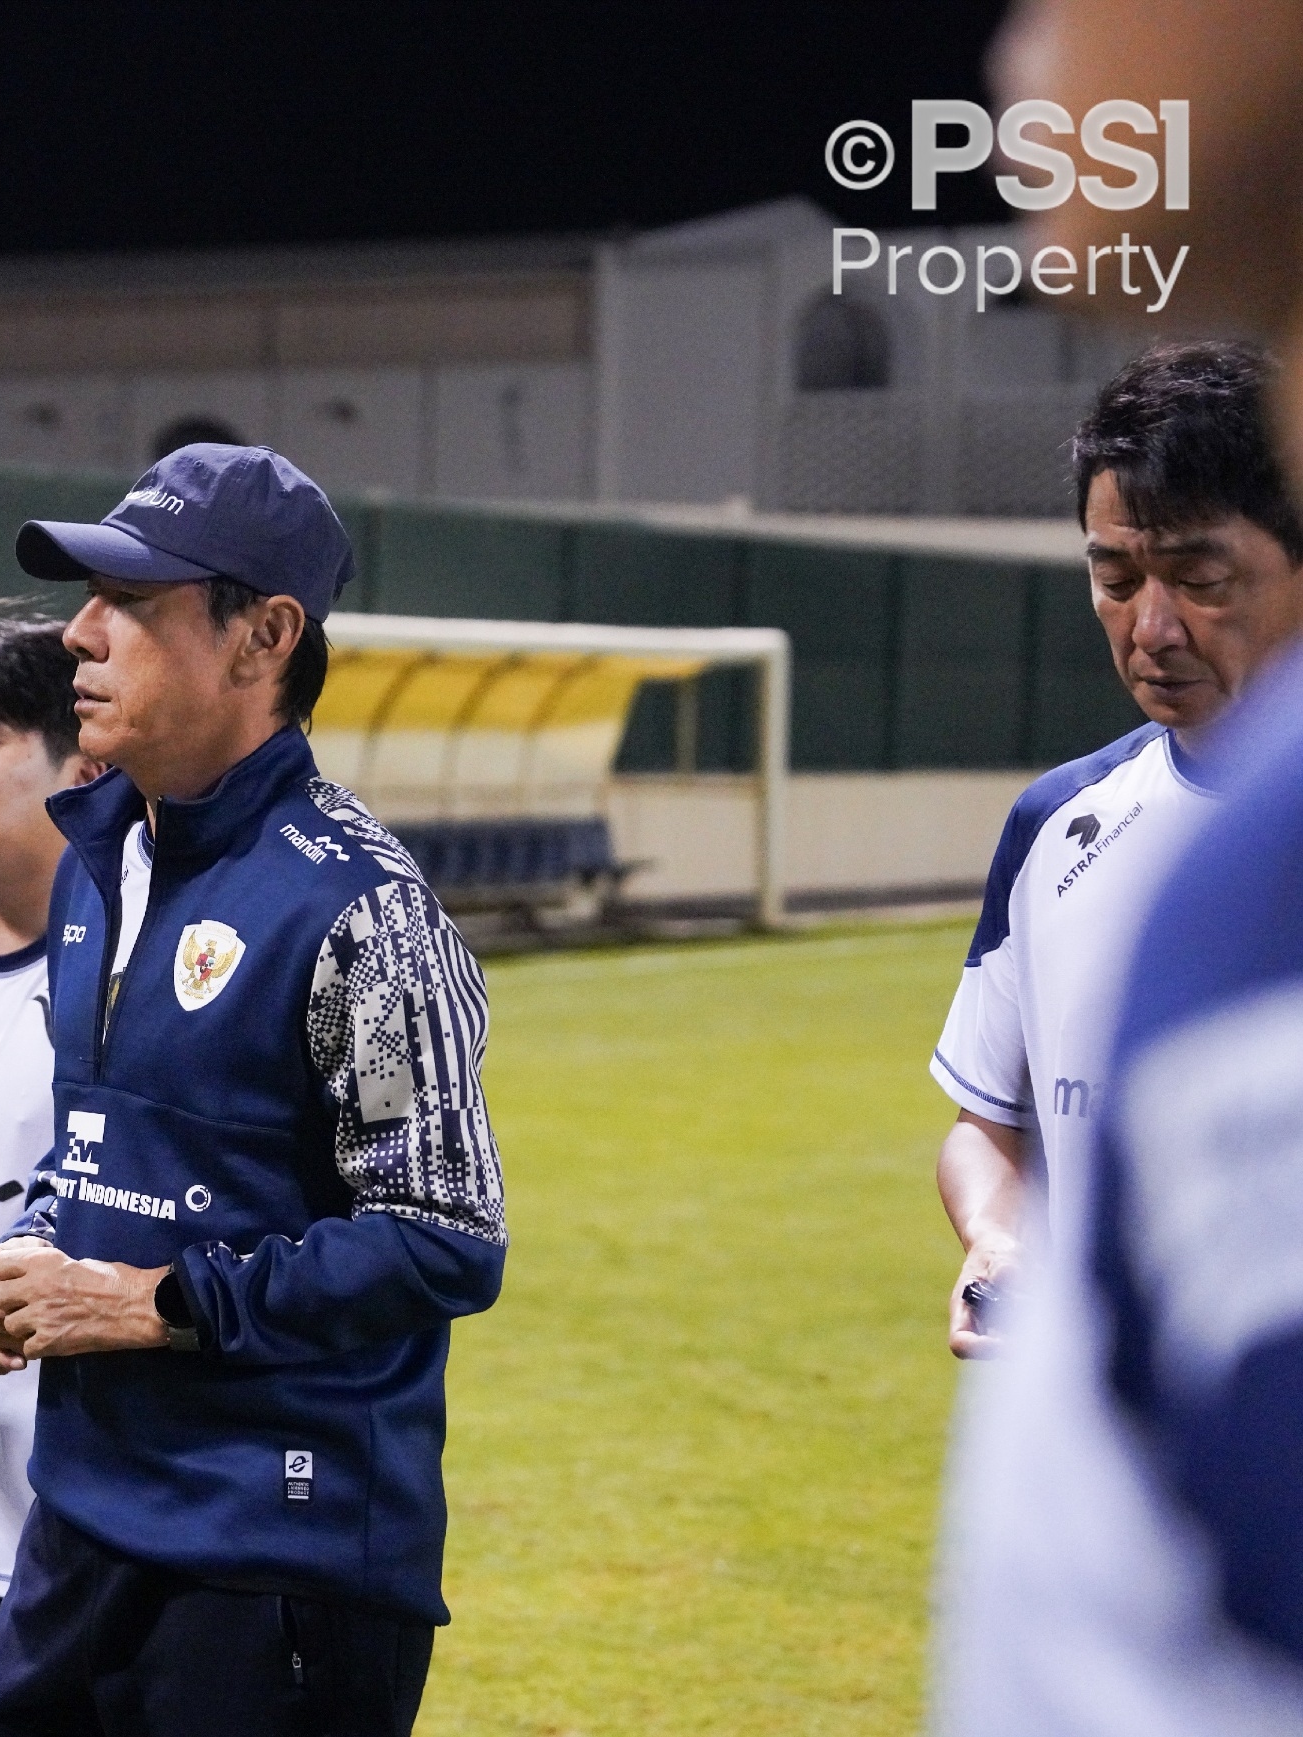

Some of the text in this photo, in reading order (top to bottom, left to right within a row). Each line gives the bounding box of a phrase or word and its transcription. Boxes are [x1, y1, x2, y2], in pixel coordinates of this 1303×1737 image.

[279, 823, 328, 865] mandiri
[1056, 801, 1144, 898] ASTRA Financial
[62, 924, 87, 947] spo
[78, 1176, 176, 1221] INDONESIA
